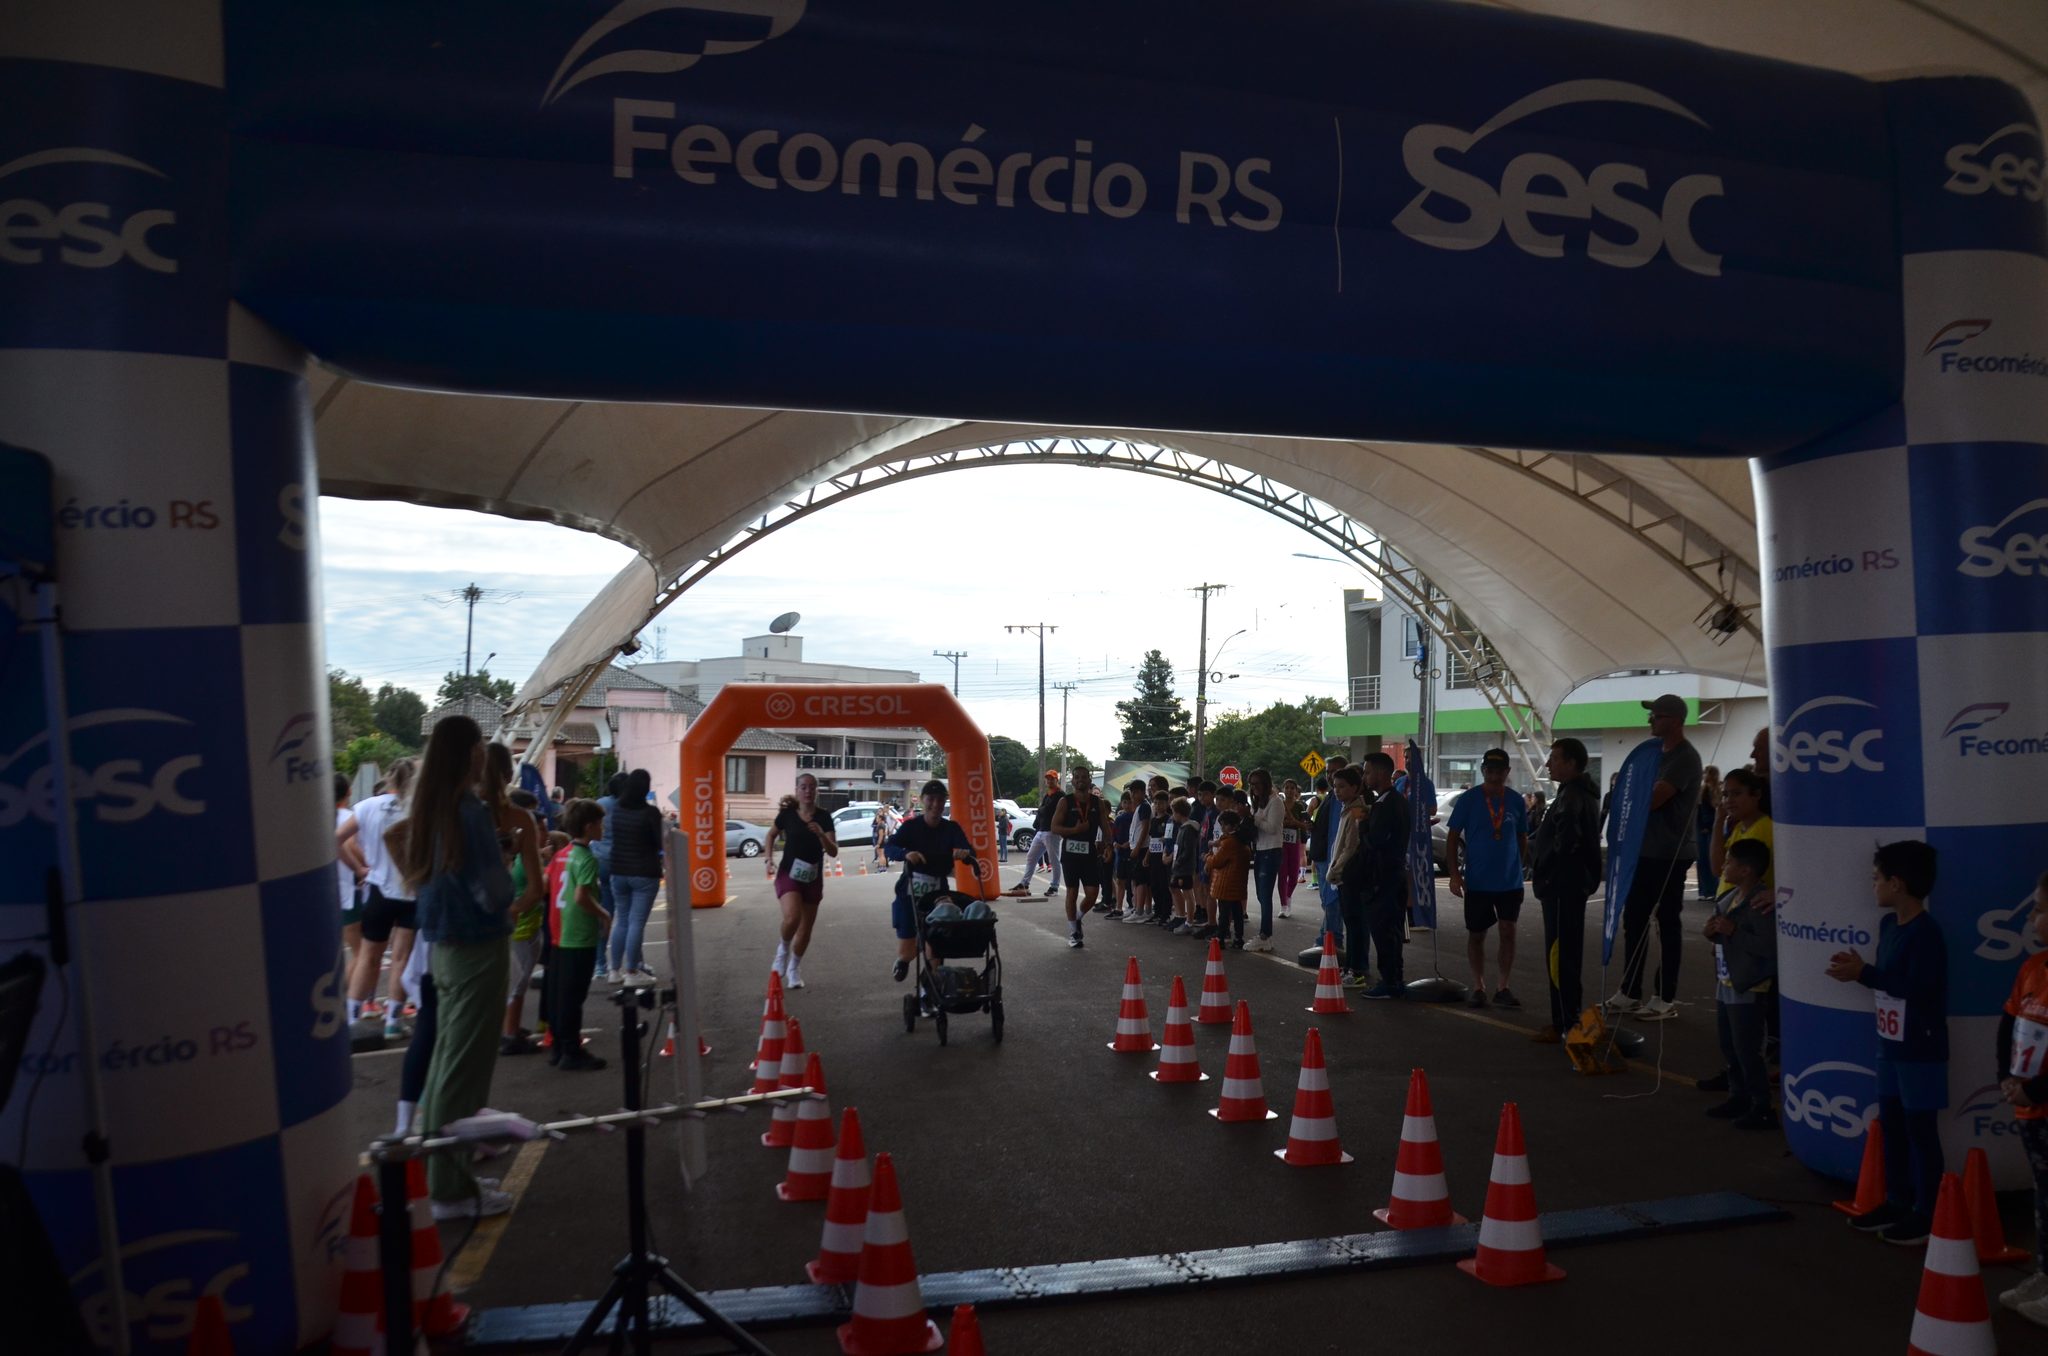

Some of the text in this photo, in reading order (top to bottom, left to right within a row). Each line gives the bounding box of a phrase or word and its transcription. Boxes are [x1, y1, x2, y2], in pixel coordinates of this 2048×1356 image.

[612, 97, 1284, 232] Fecomércio RS
[1391, 120, 1725, 277] Sesc
[168, 500, 220, 531] RS
[1862, 548, 1900, 571] RS
[804, 694, 912, 716] CRESOL
[693, 769, 714, 861] CRESOL
[967, 763, 990, 851] CRESOL
[1069, 842, 1087, 853] 245
[208, 1021, 258, 1056] RS
